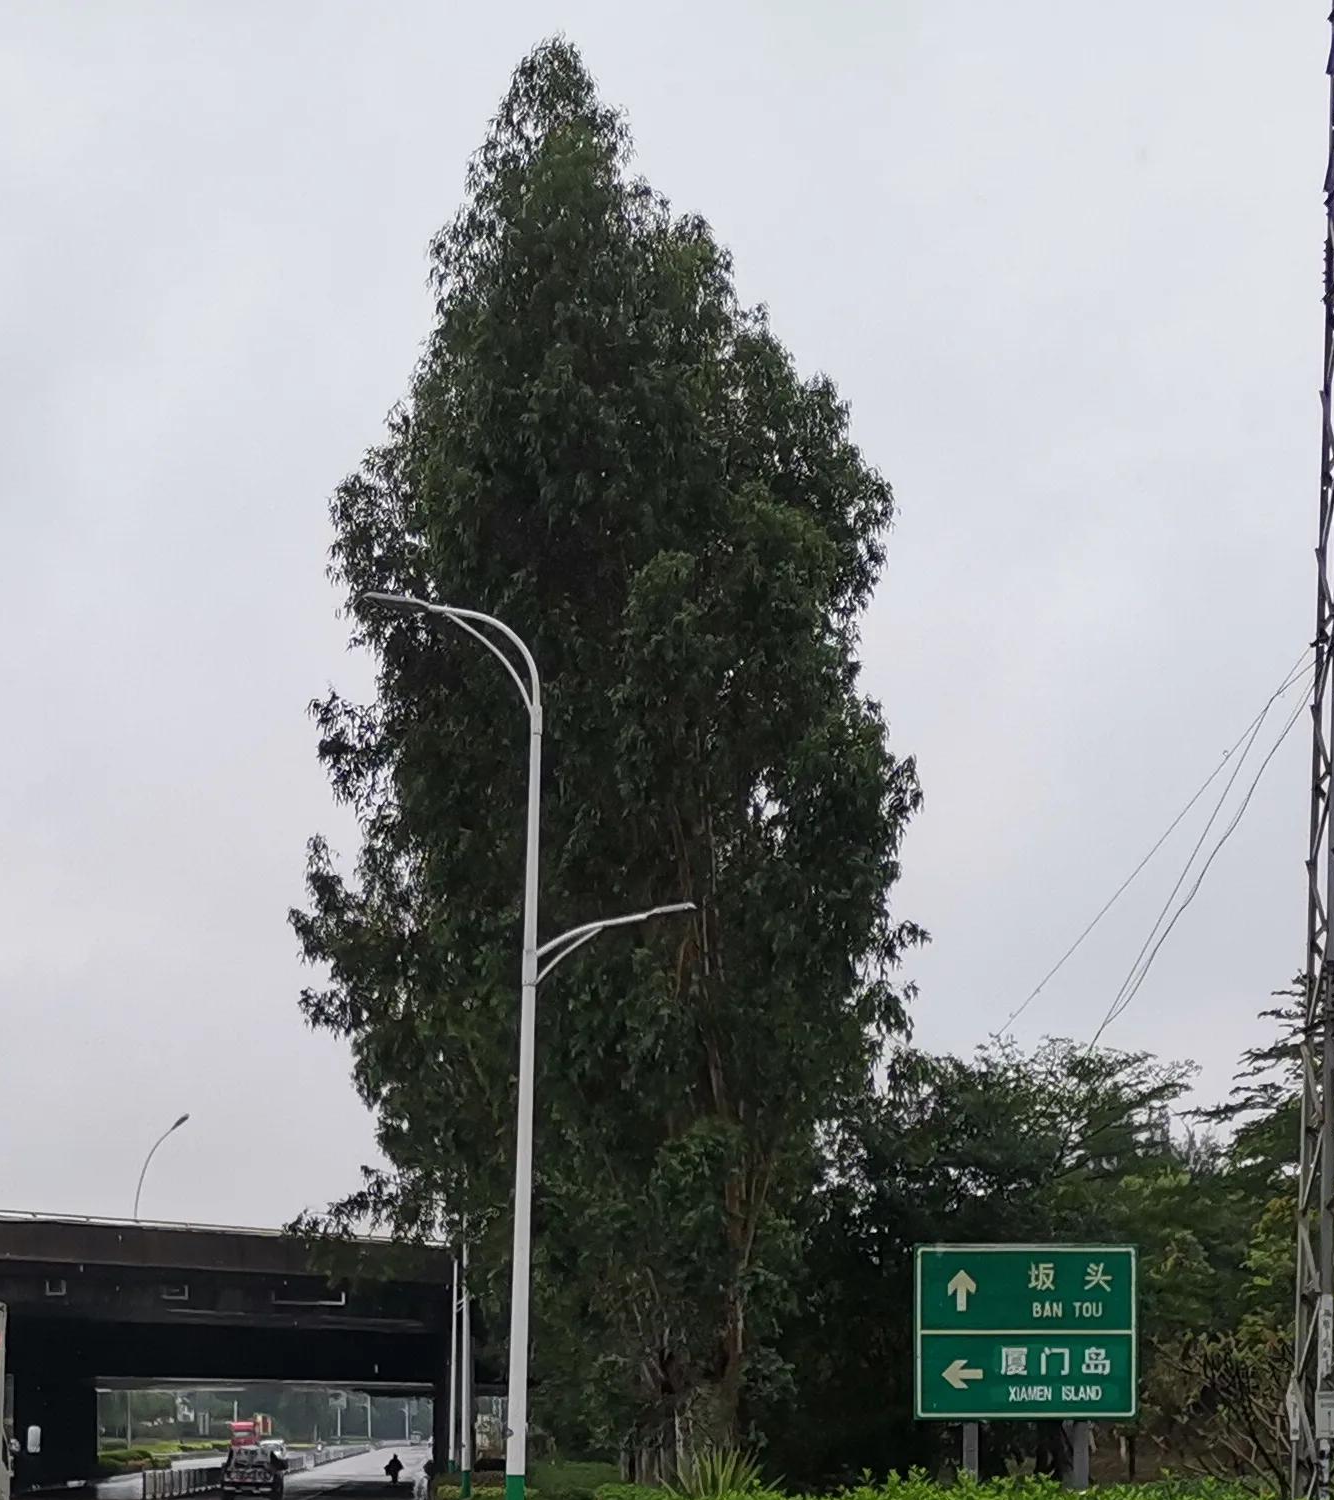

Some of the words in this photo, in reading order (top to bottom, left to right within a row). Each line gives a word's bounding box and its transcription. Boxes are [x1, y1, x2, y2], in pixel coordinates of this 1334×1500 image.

[1027, 1261, 1113, 1293] 坂头
[1032, 1301, 1063, 1318] BAN
[1073, 1301, 1103, 1318] TOU
[1000, 1346, 1111, 1376] 厦门岛
[1008, 1385, 1052, 1402] XIAMEN
[1061, 1385, 1102, 1401] ISLAND
